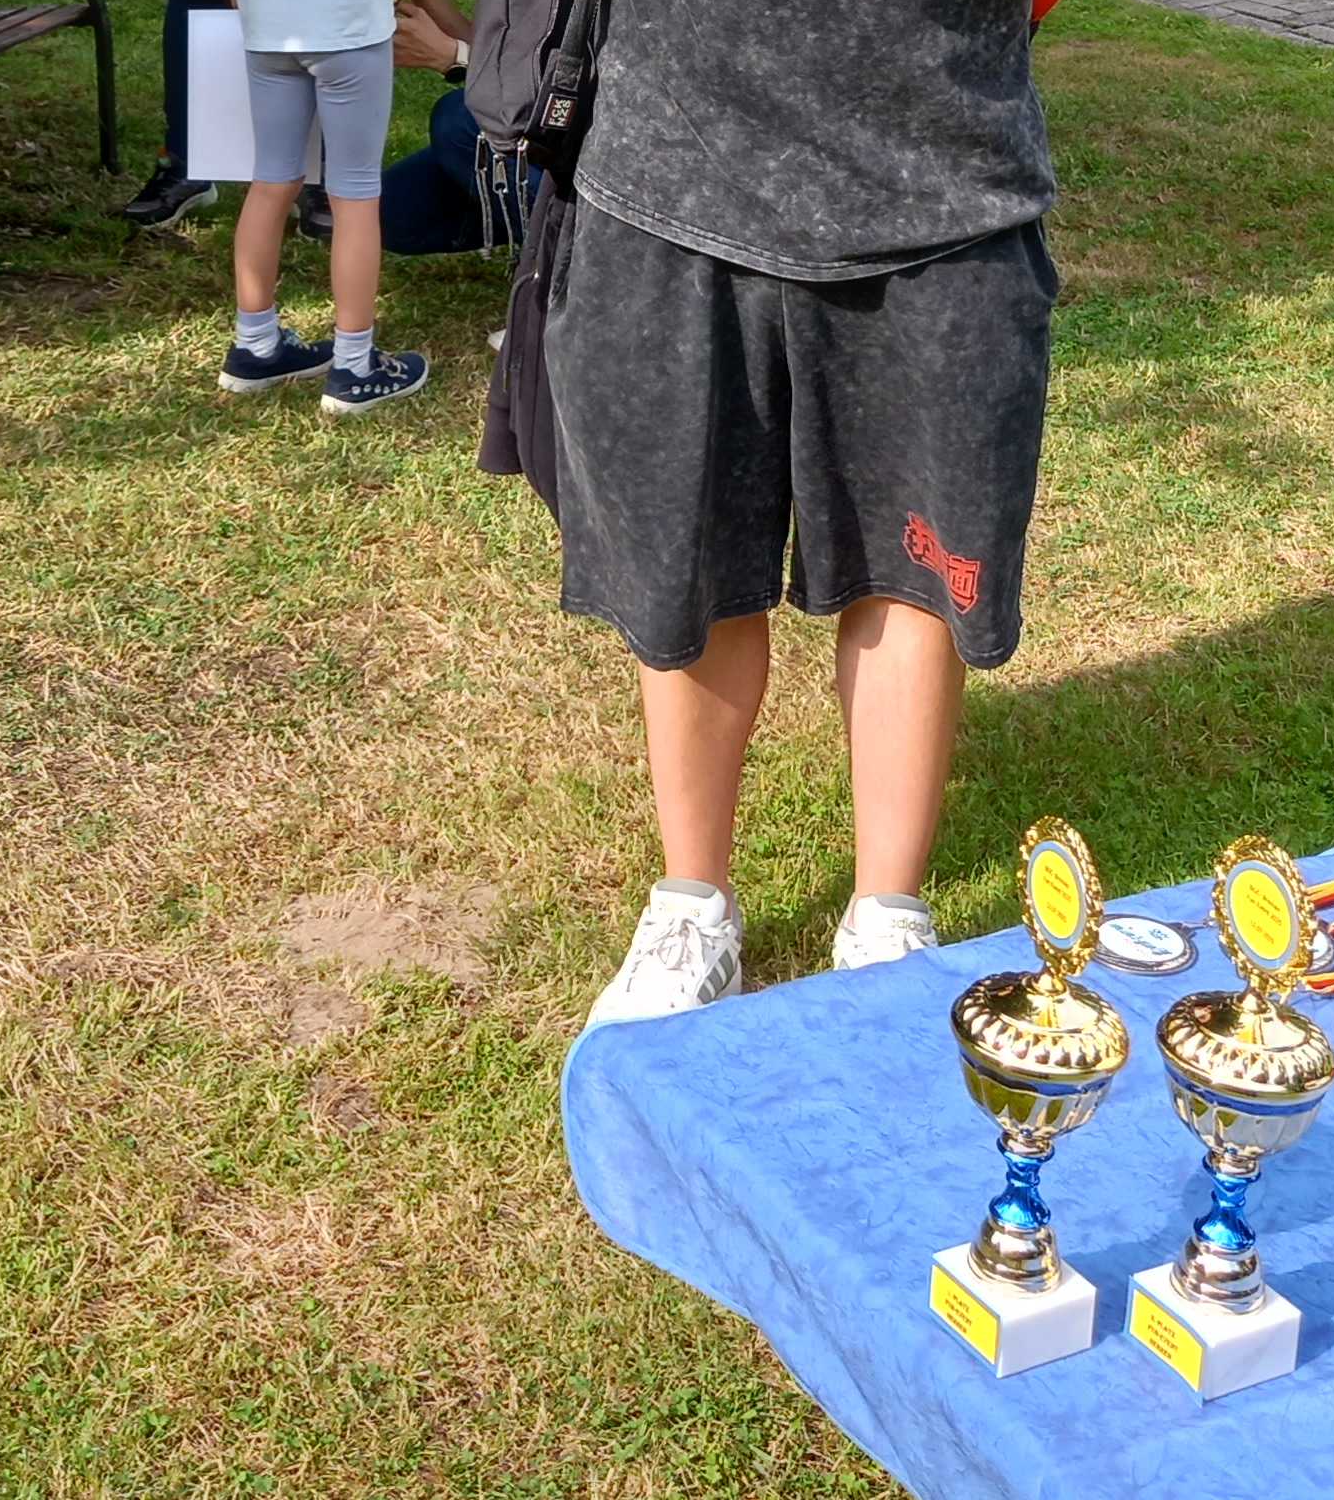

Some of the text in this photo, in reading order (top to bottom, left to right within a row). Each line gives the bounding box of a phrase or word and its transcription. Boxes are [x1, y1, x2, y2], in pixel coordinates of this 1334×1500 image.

[548, 99, 563, 125] FCK
[556, 100, 571, 127] NZS
[888, 916, 928, 936] adida
